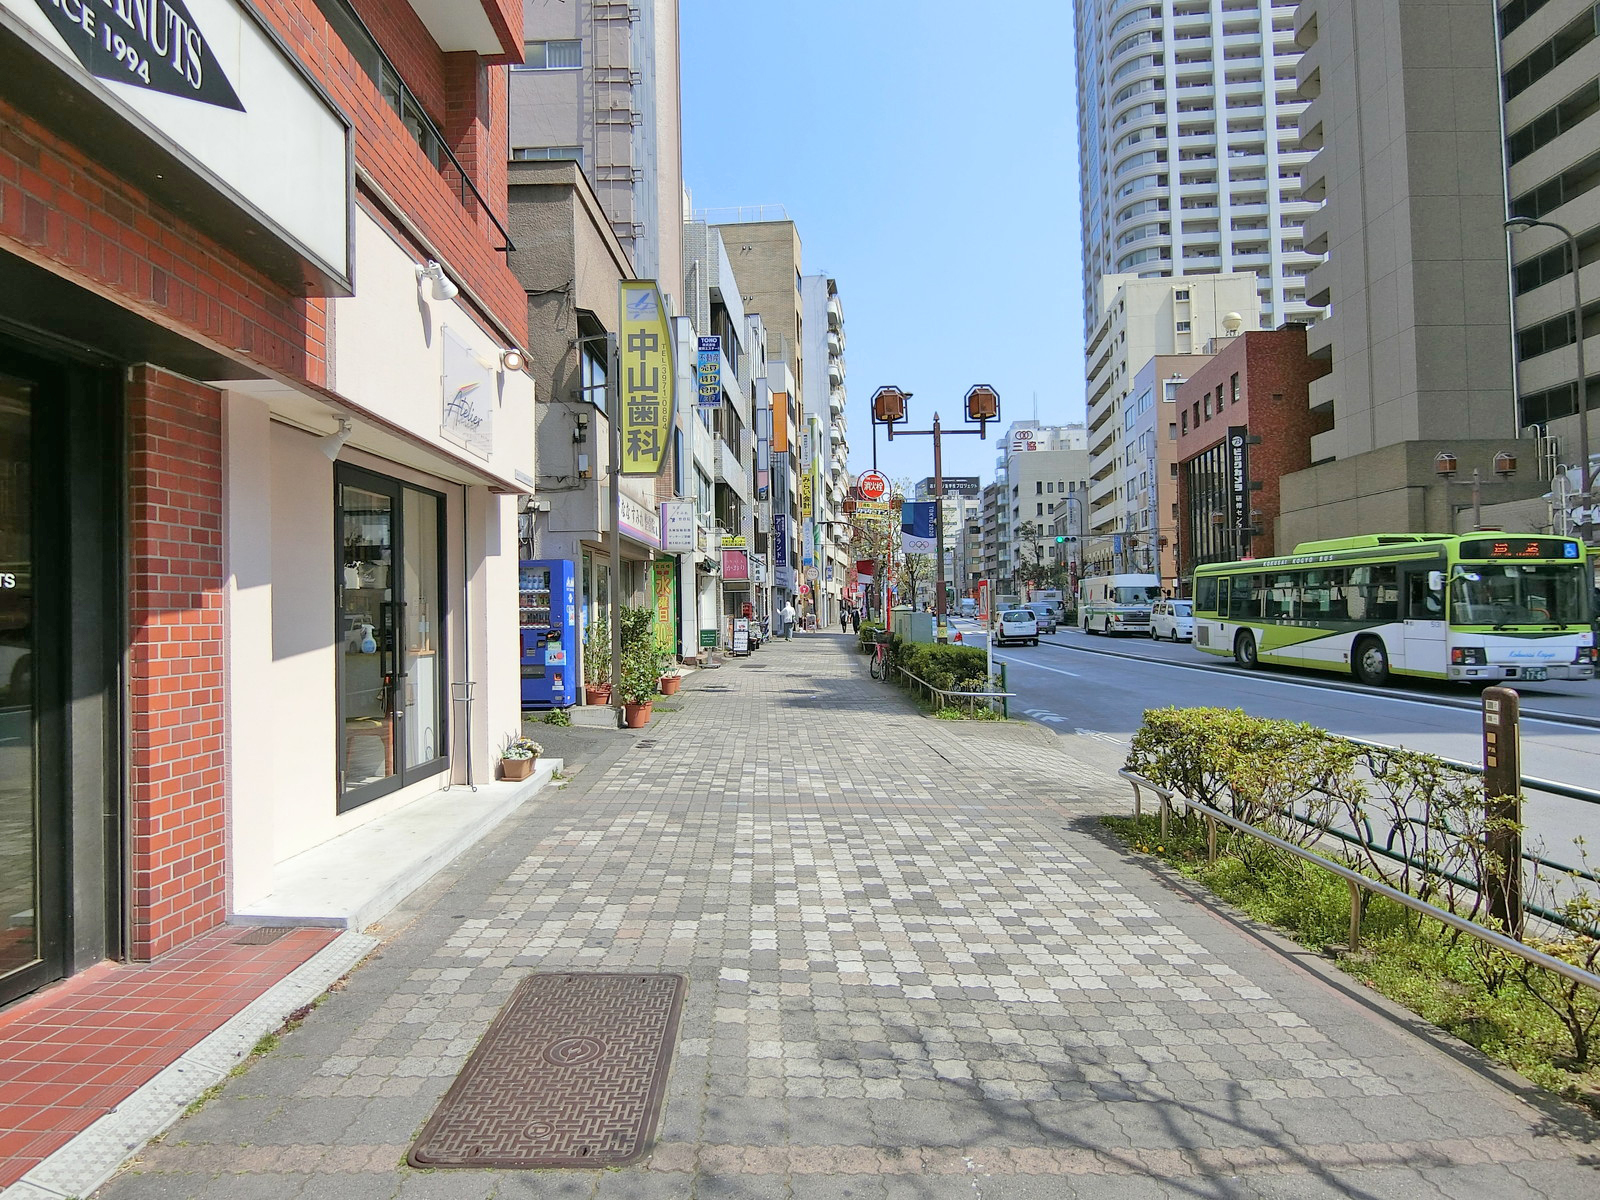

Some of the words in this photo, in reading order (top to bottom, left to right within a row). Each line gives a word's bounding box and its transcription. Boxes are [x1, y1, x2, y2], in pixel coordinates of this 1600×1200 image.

[52, 0, 96, 38] CE
[104, 23, 151, 85] 1994
[699, 353, 720, 362] 不動産
[627, 328, 660, 462] 中山歯科
[802, 476, 811, 509] みらい会計
[863, 481, 884, 492] 消火栓
[1262, 559, 1288, 567] KOKUSAI
[656, 576, 672, 622] 水曜日
